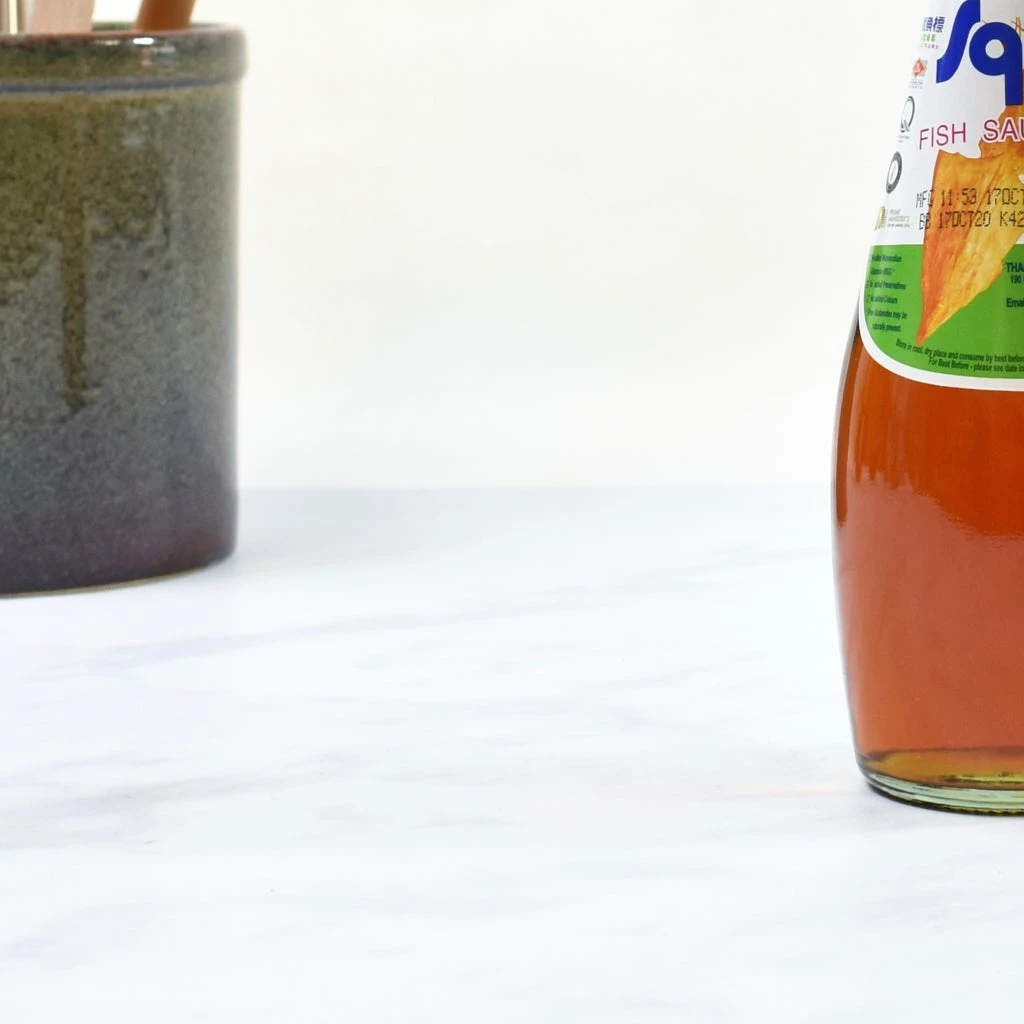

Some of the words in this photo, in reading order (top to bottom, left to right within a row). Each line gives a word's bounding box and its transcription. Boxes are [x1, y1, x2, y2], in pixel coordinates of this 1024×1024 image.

[919, 122, 967, 150] FISH
[939, 210, 991, 229] 17OCT20
[938, 358, 950, 368] Best
[951, 359, 969, 370] Before
[1004, 363, 1018, 372] date
[948, 351, 958, 359] and
[986, 353, 993, 363] by
[994, 354, 1007, 362] best
